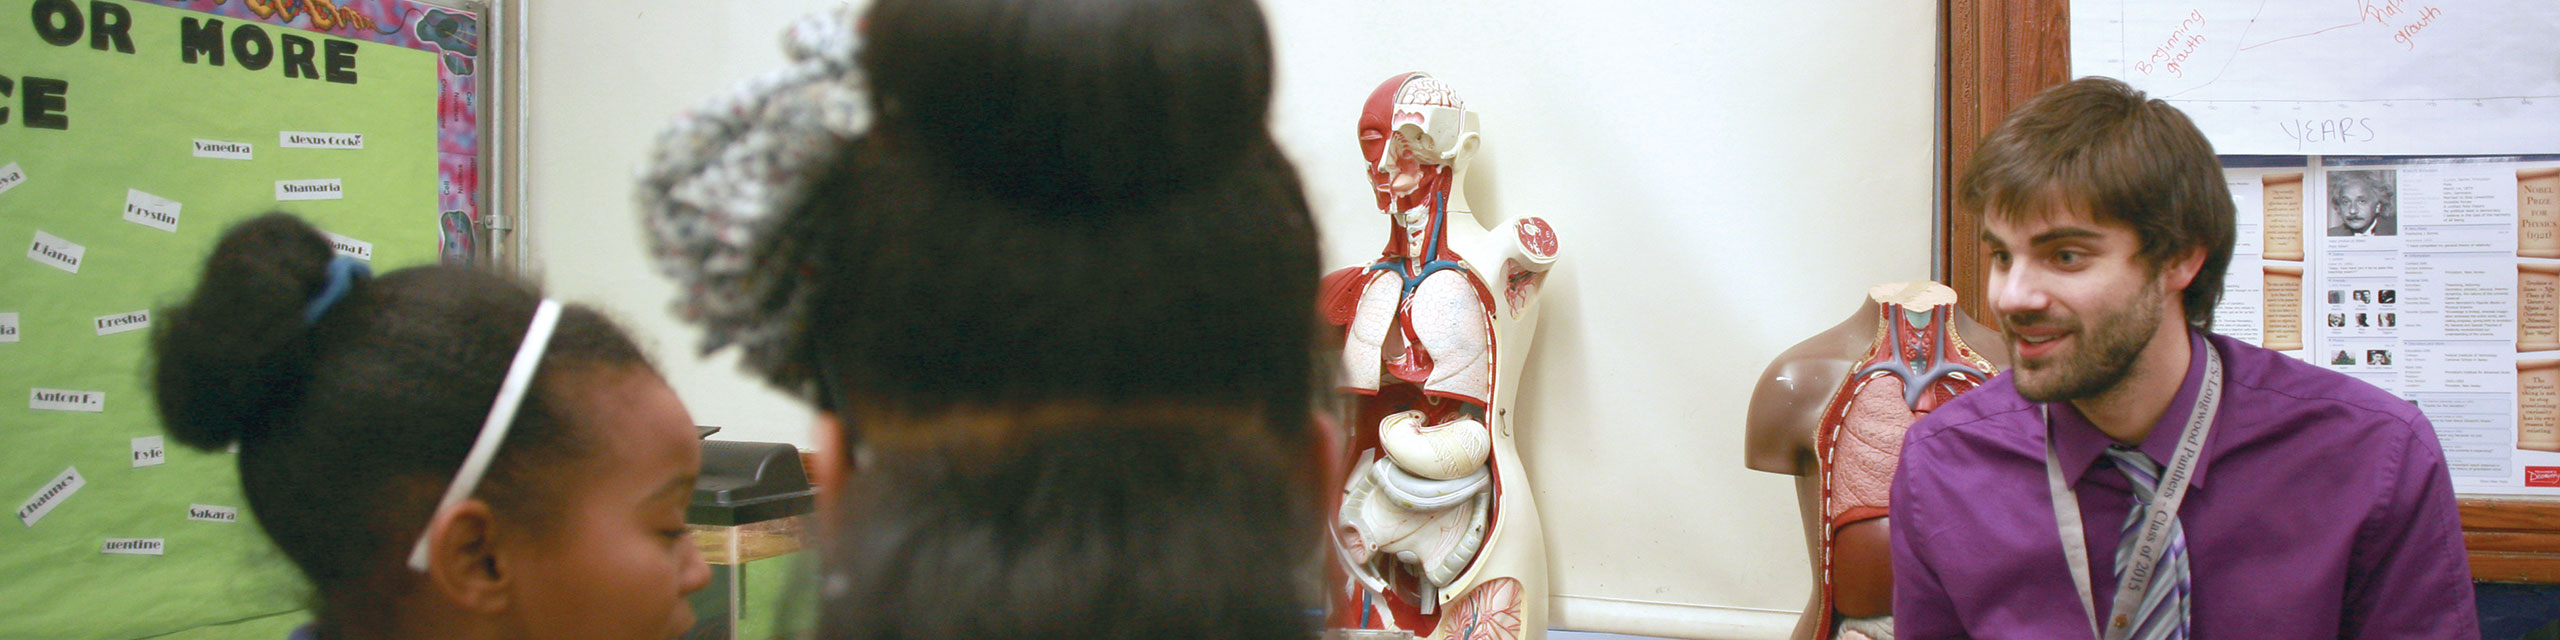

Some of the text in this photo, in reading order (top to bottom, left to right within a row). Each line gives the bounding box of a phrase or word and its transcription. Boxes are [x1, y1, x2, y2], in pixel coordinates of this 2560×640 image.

[31, 0, 359, 85] OR MORE
[2134, 9, 2206, 76] Beginning
[2394, 6, 2442, 51] growth
[2167, 34, 2207, 79] growth
[194, 141, 250, 154] Vanedra
[288, 135, 326, 145] Alexus
[2280, 117, 2375, 151] YEARS
[283, 182, 341, 193] Shamaria
[127, 203, 176, 225] Krystin
[33, 391, 79, 403] Anton
[2163, 447, 2196, 500] Panthers
[19, 474, 75, 519] Chauncy
[190, 508, 235, 520] Sakara
[2146, 510, 2169, 543] Class
[106, 539, 161, 550] uentine
[2140, 545, 2153, 563] of
[2128, 561, 2150, 592] 2015
